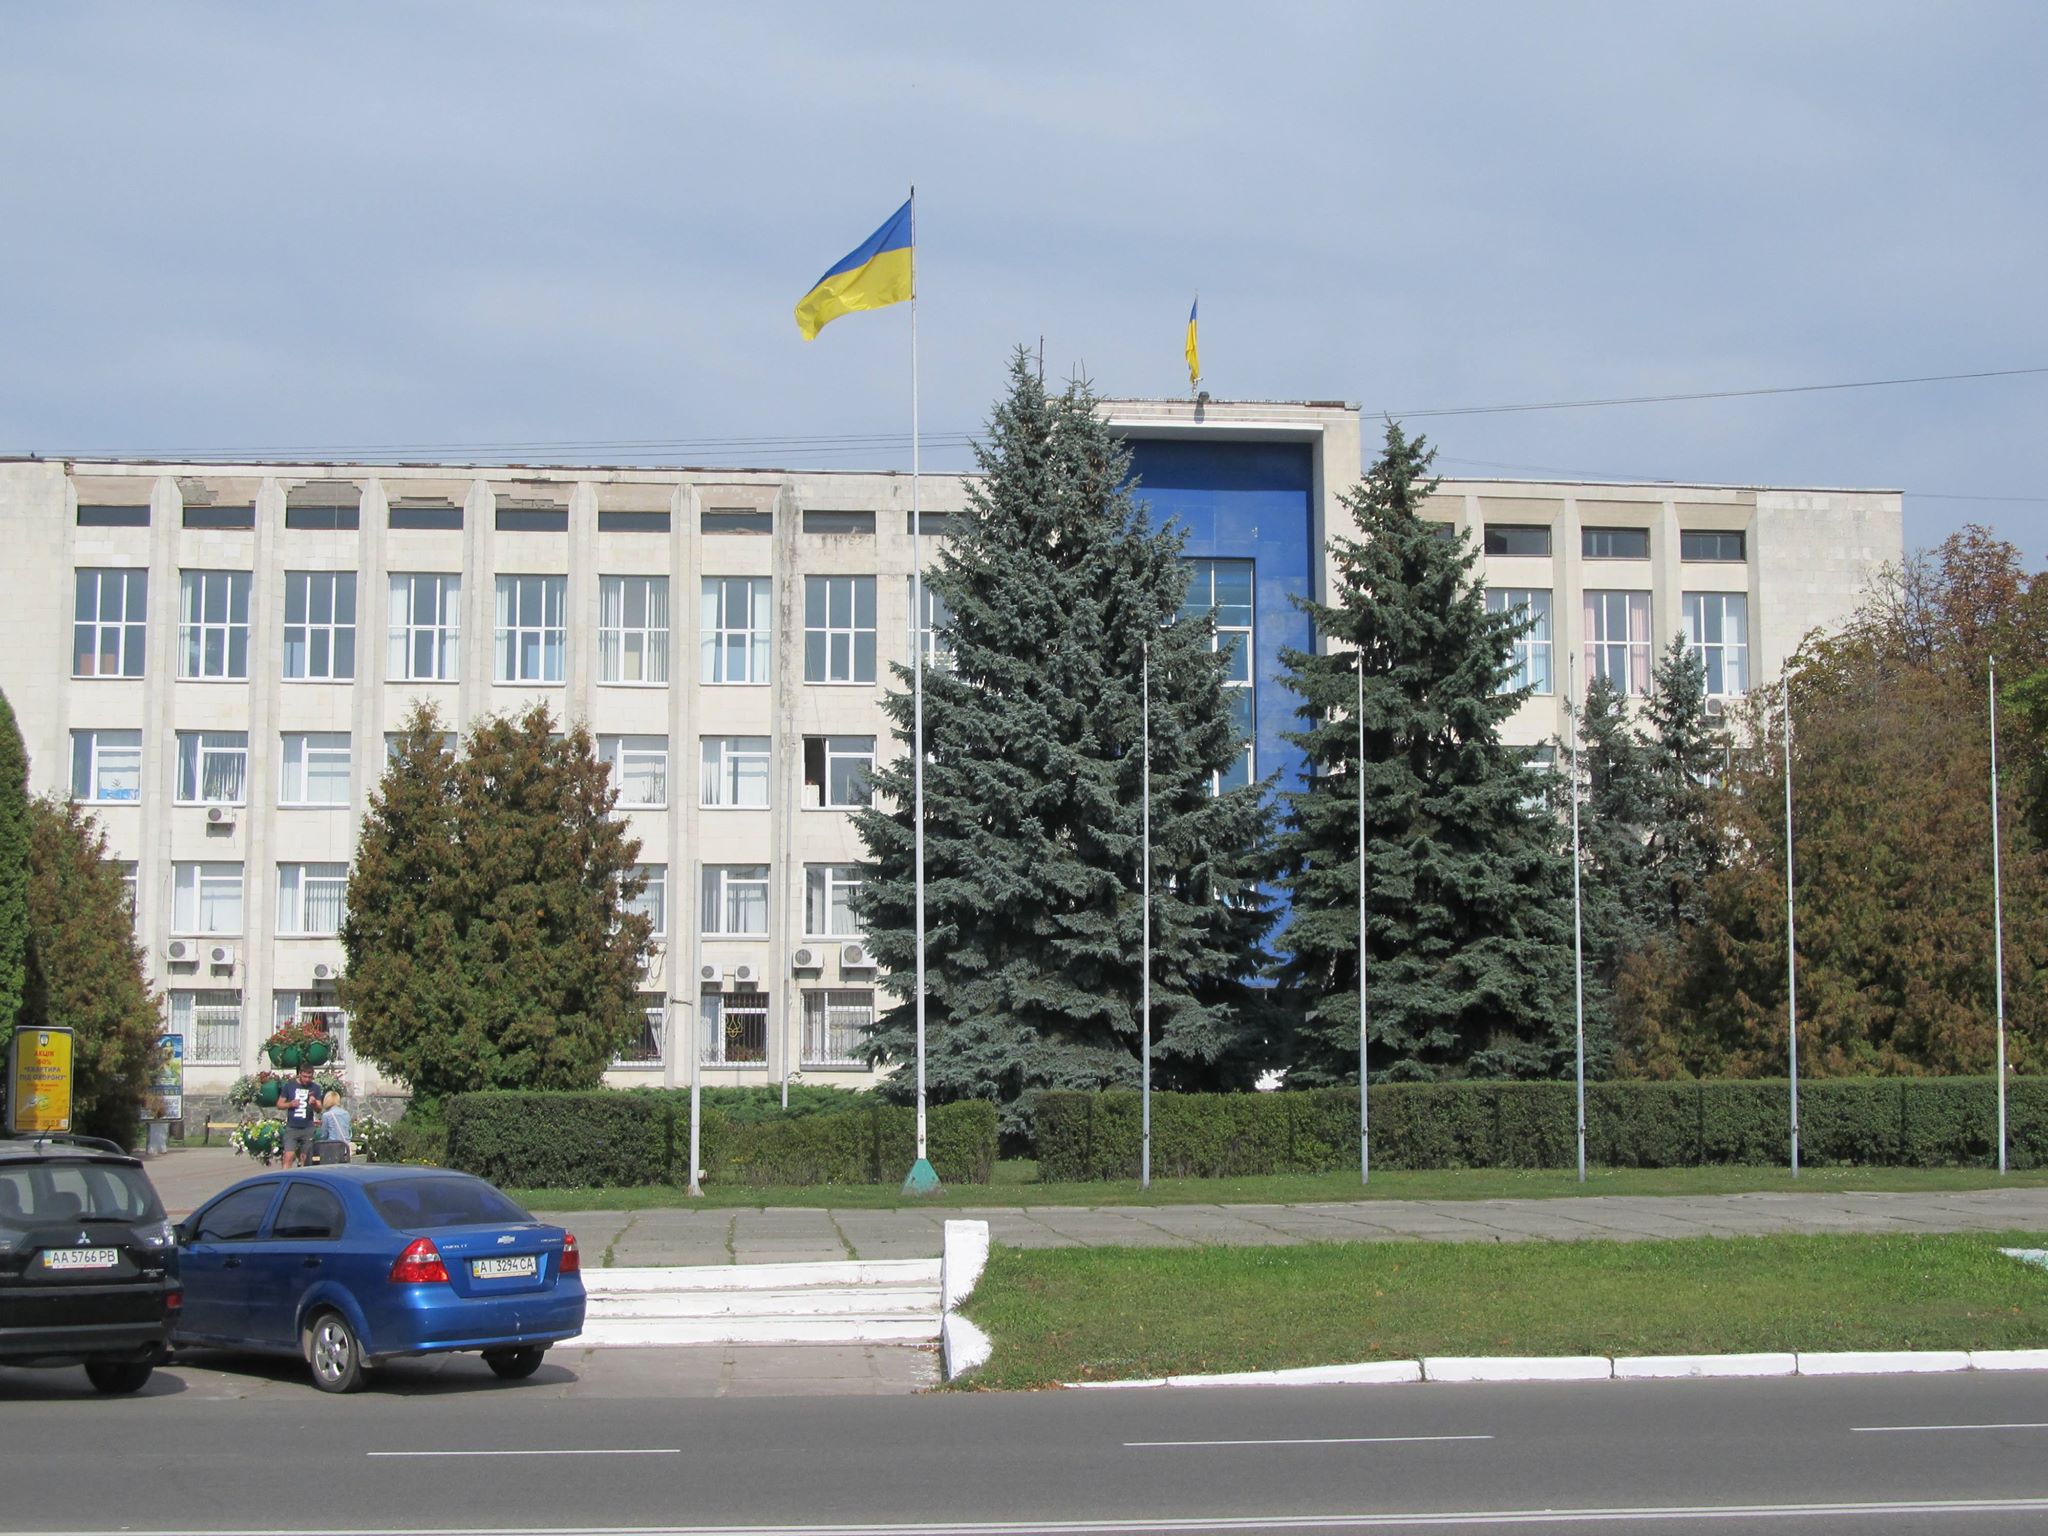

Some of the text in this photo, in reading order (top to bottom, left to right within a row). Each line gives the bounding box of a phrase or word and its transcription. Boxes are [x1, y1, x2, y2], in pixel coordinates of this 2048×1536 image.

[53, 1250, 116, 1264] AA 5766 PB
[480, 1257, 534, 1273] AI 3294 CA
